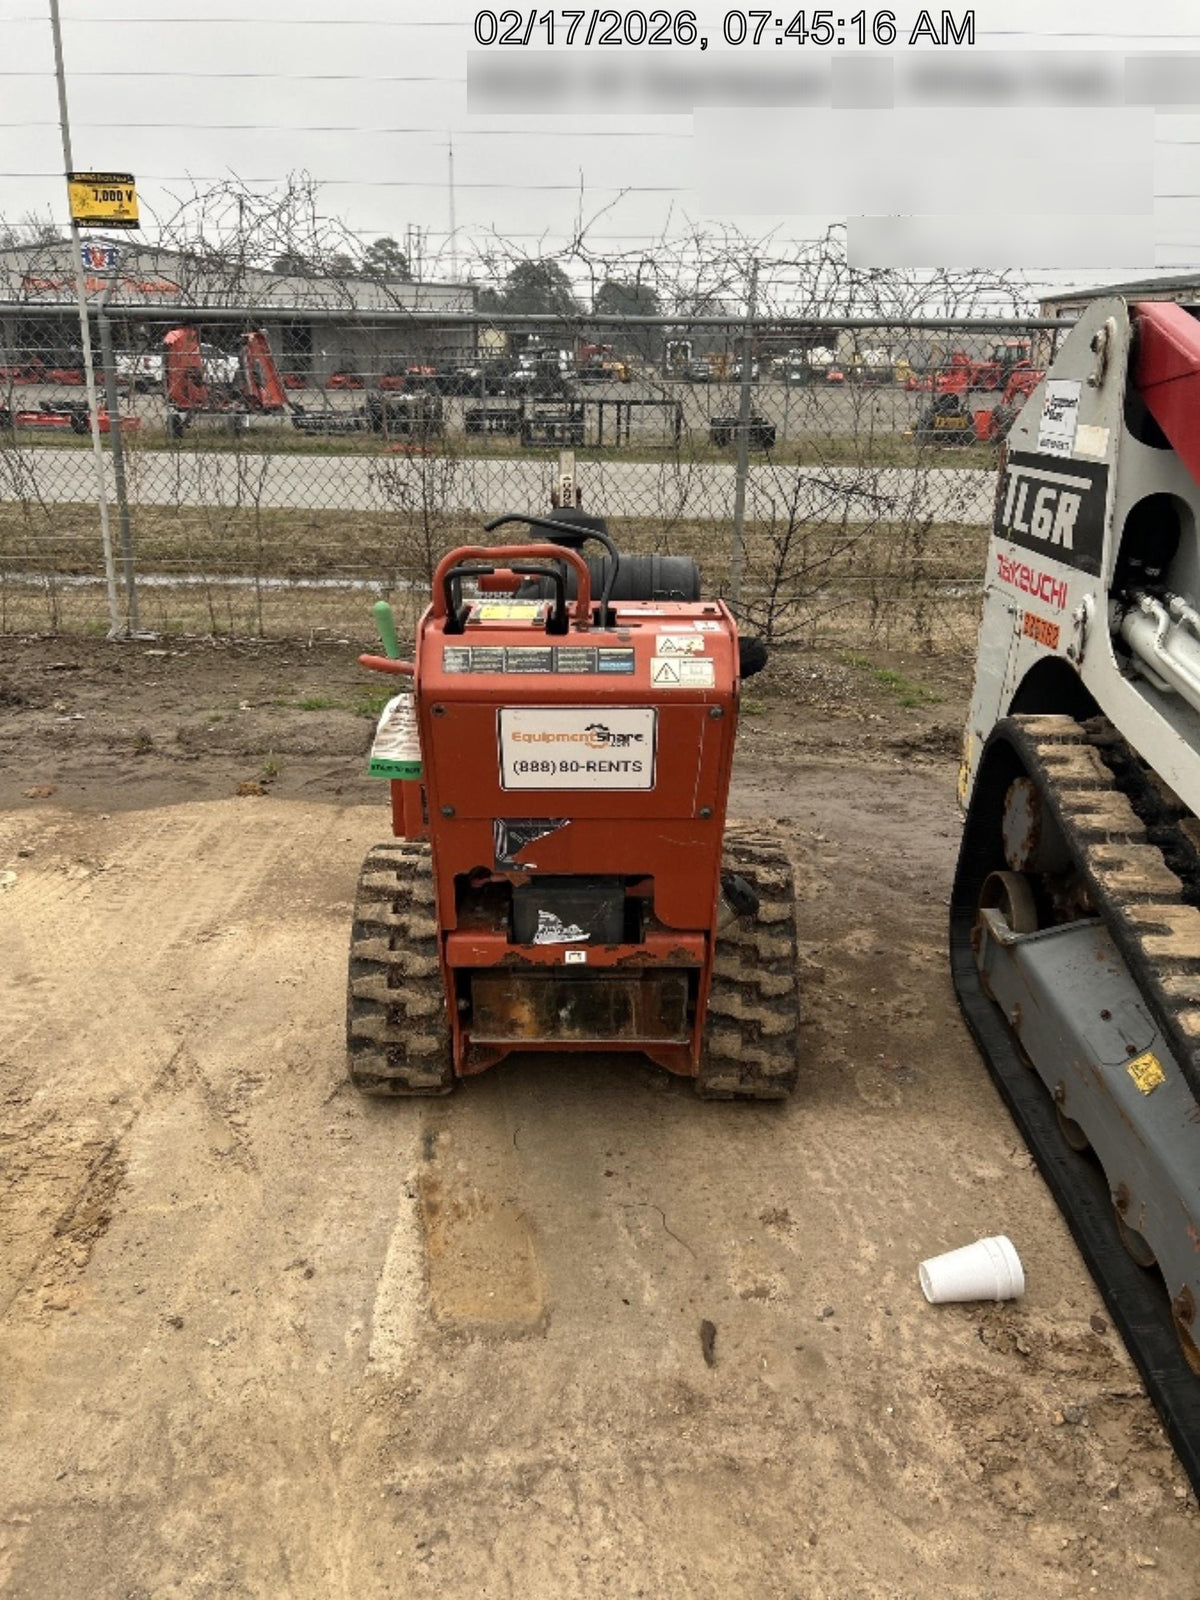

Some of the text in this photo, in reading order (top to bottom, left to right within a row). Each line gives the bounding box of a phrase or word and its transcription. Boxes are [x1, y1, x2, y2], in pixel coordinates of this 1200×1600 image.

[92, 189, 133, 203] 7,000 V
[1002, 463, 1092, 550] TL6R
